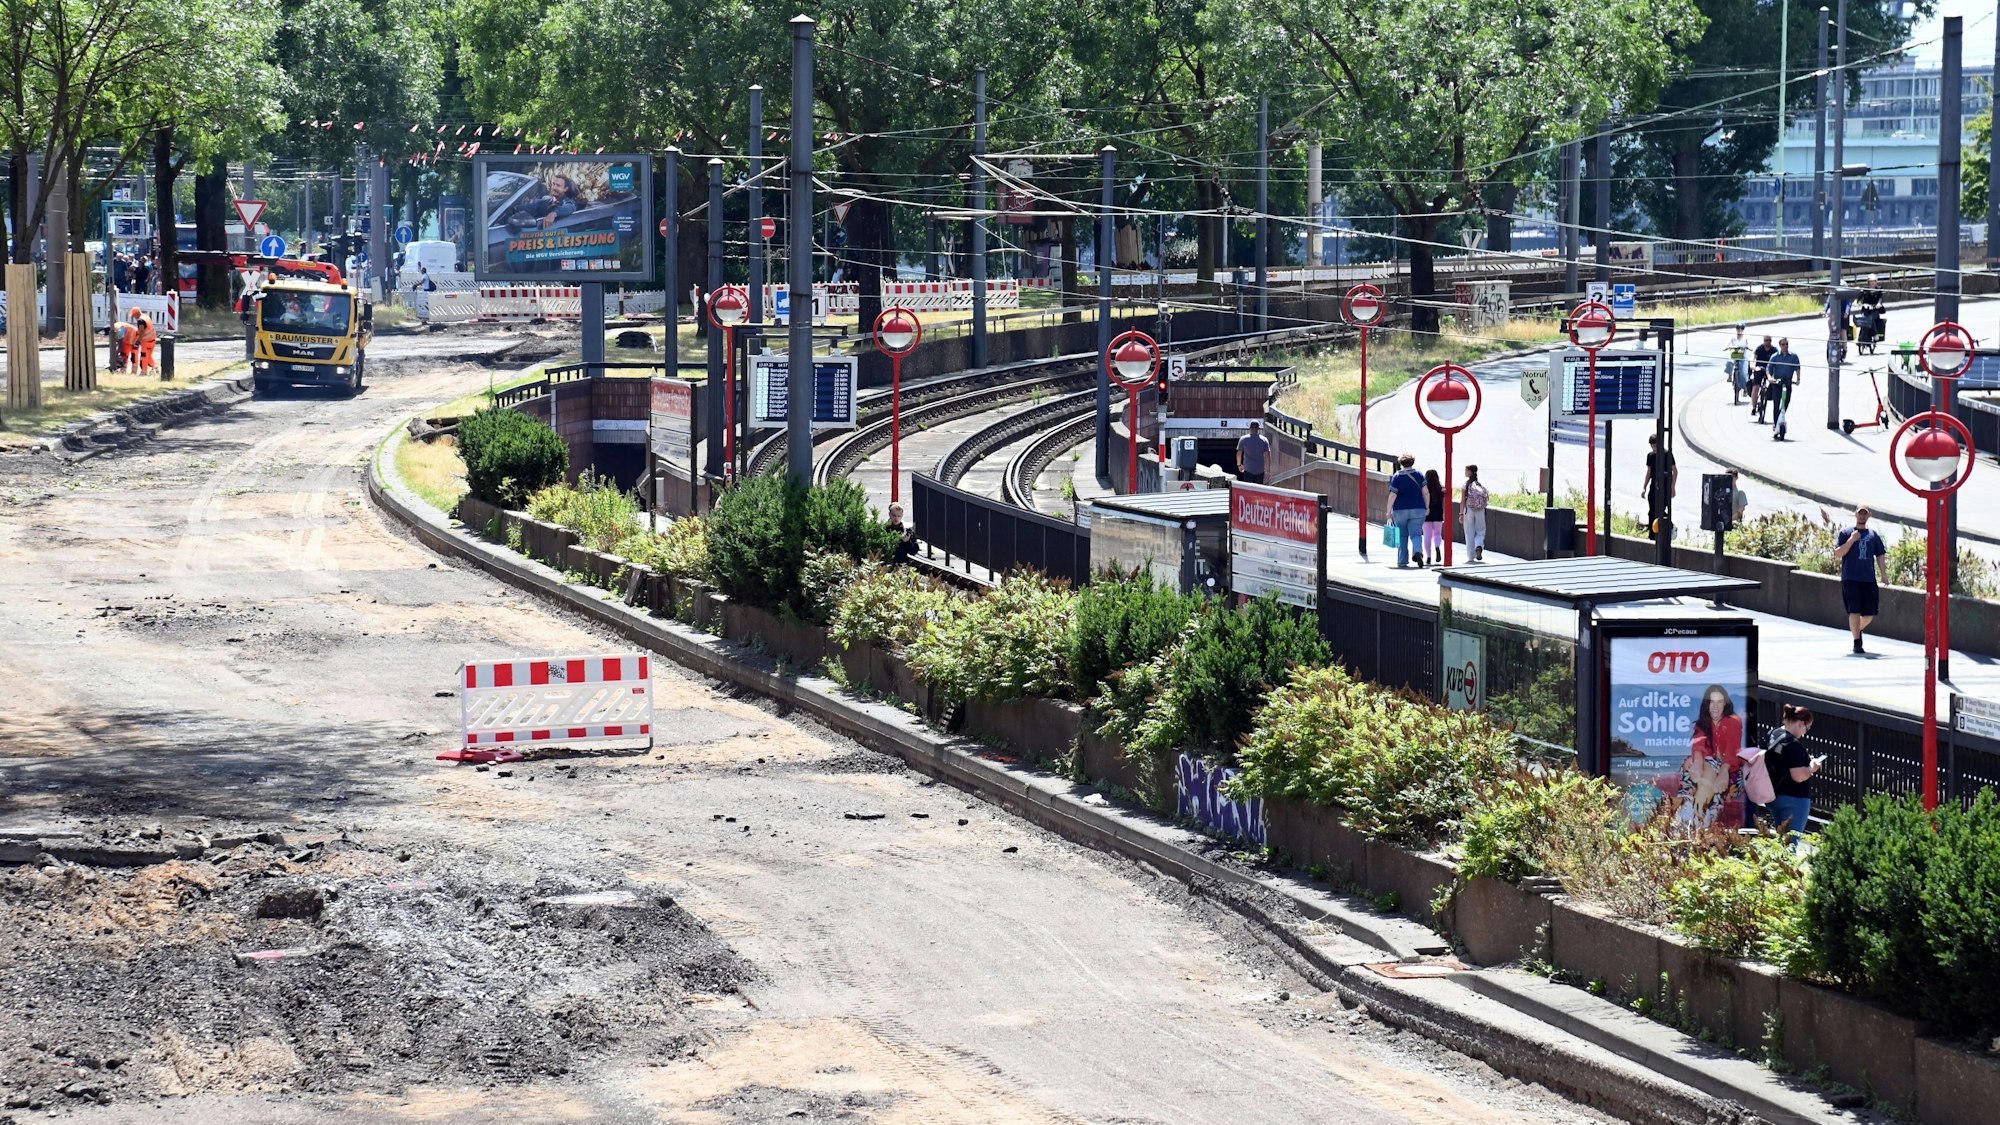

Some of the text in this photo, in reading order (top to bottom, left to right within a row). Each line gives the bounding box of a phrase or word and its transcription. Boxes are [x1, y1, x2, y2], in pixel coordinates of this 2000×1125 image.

[510, 232, 616, 252] PREIS & LEISTUNG
[812, 298, 819, 315] 1
[1592, 292, 1603, 308] 2
[275, 334, 333, 344] BAUMEISTER
[1172, 360, 1183, 377] 5
[1238, 495, 1310, 534] Deutzer Freiheit
[1648, 651, 1709, 673] OTTO
[1446, 666, 1464, 692] KVB
[1619, 692, 1690, 708] Auf dicke
[1618, 711, 1690, 733] Sohle
[1645, 736, 1692, 747] machen
